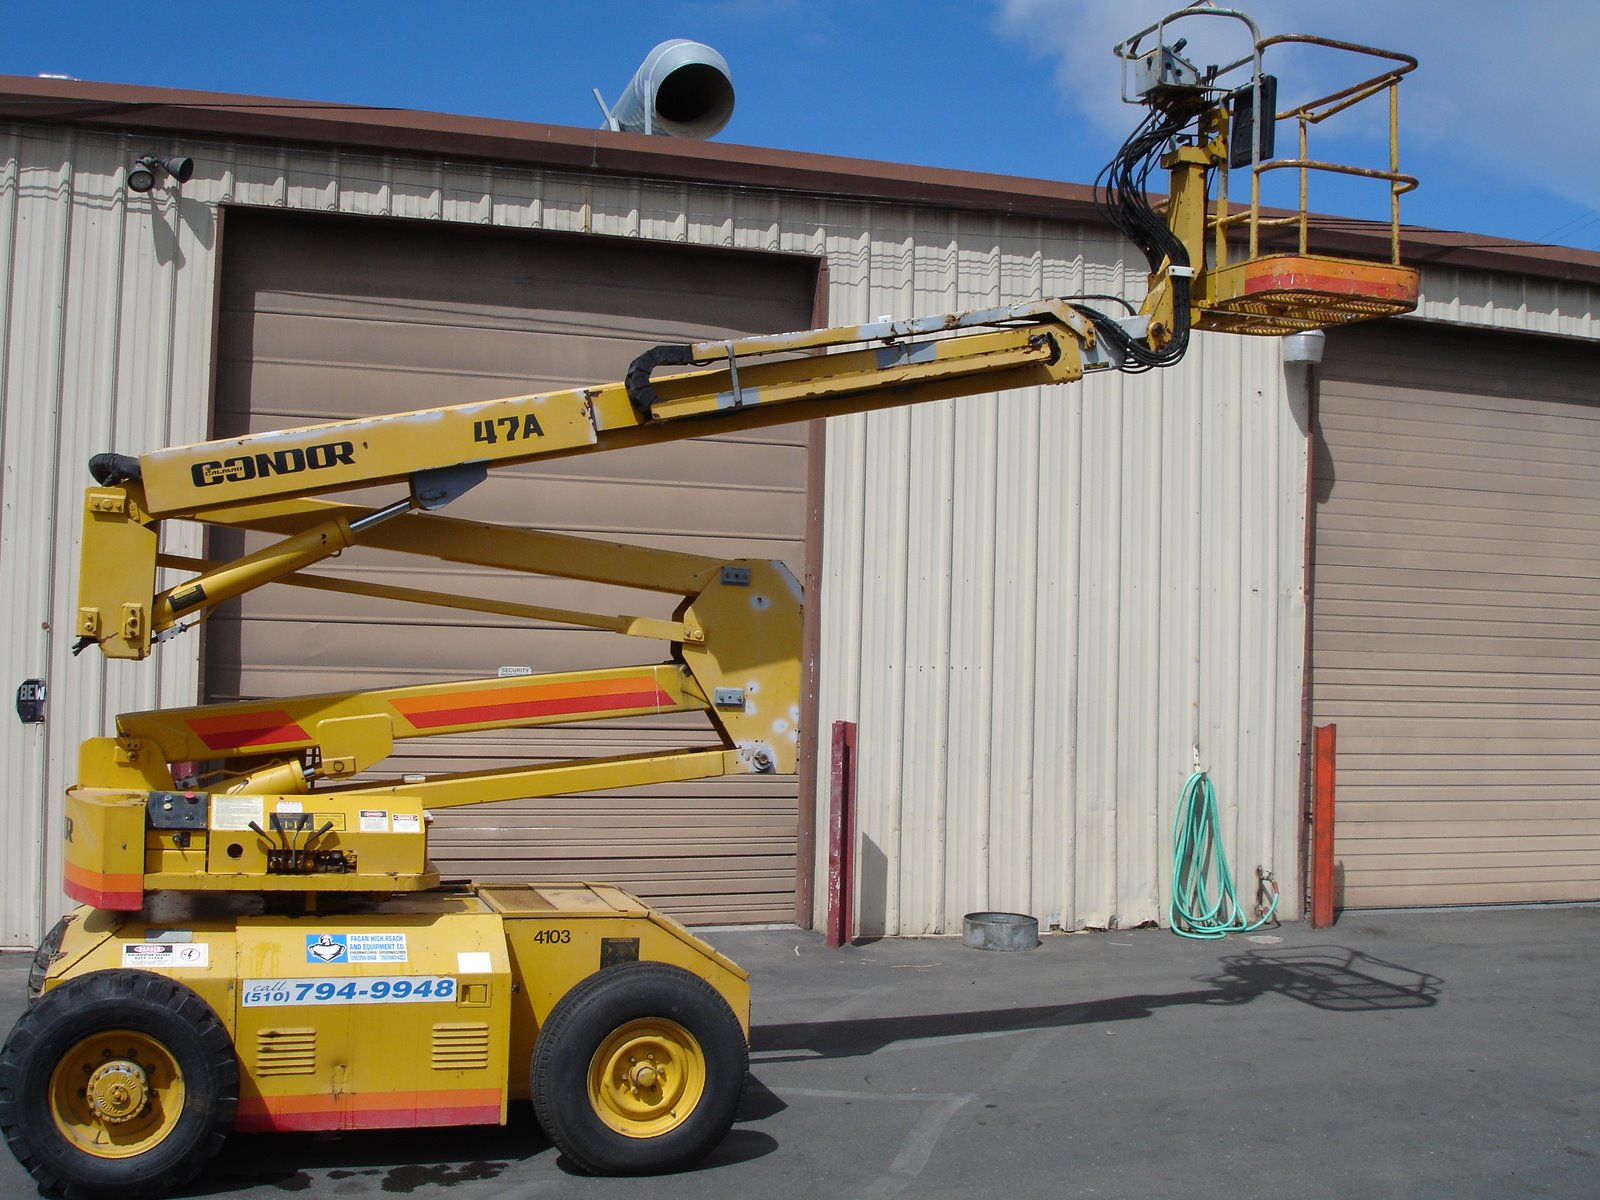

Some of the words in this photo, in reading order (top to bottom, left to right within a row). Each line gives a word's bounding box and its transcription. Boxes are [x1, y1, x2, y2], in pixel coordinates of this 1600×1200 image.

[474, 413, 545, 444] 47A
[191, 441, 356, 488] CONDOR
[533, 929, 571, 944] 4103
[244, 990, 290, 1004] (510)
[294, 979, 454, 1001] 794-9948
[253, 981, 287, 992] call
